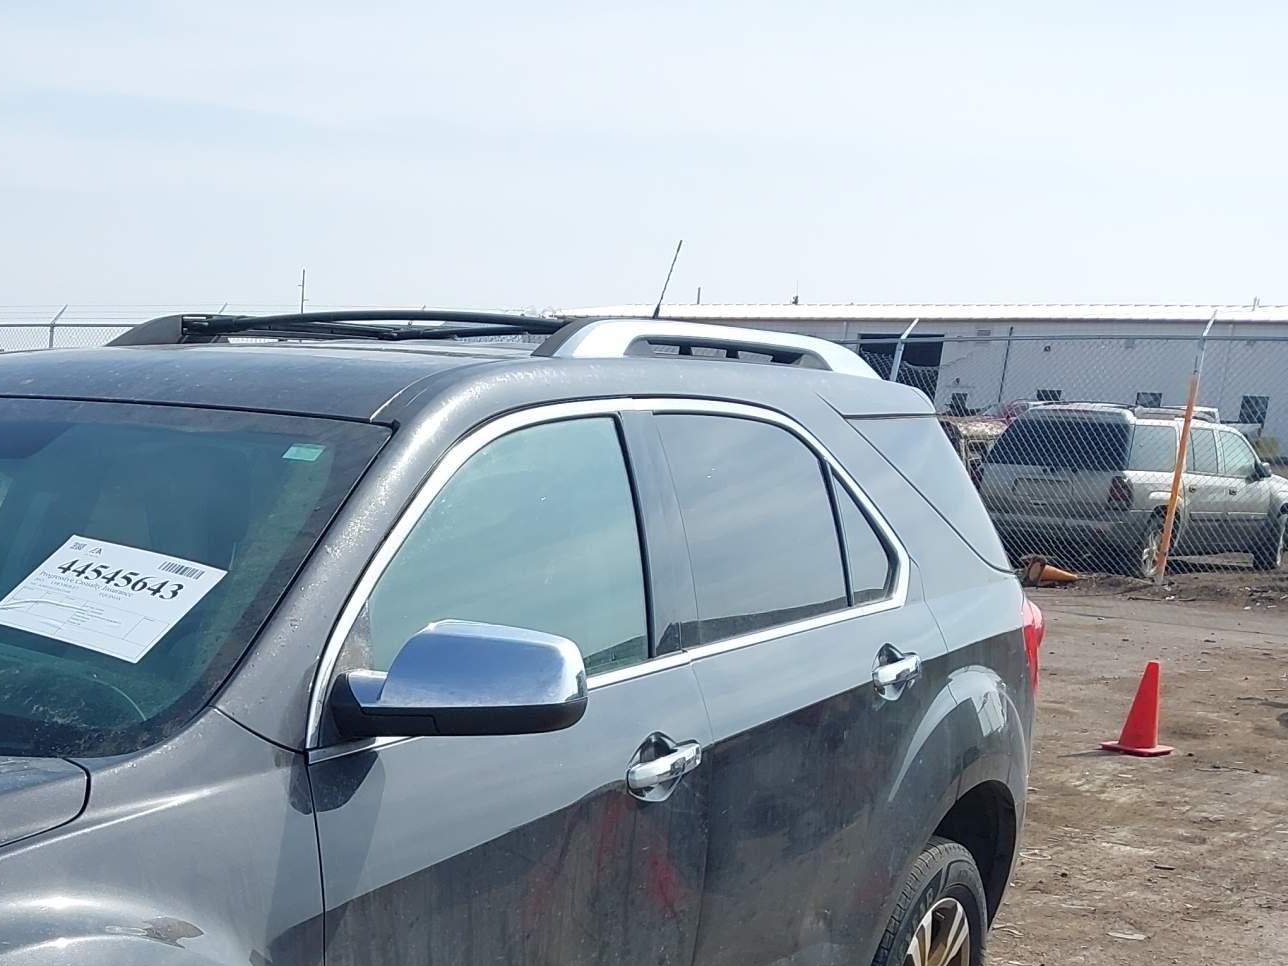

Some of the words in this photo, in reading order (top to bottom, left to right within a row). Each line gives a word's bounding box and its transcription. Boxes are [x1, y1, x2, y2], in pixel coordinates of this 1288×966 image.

[40, 571, 75, 584] Progressive
[101, 584, 134, 599] Insurance
[57, 559, 184, 600] 44545643
